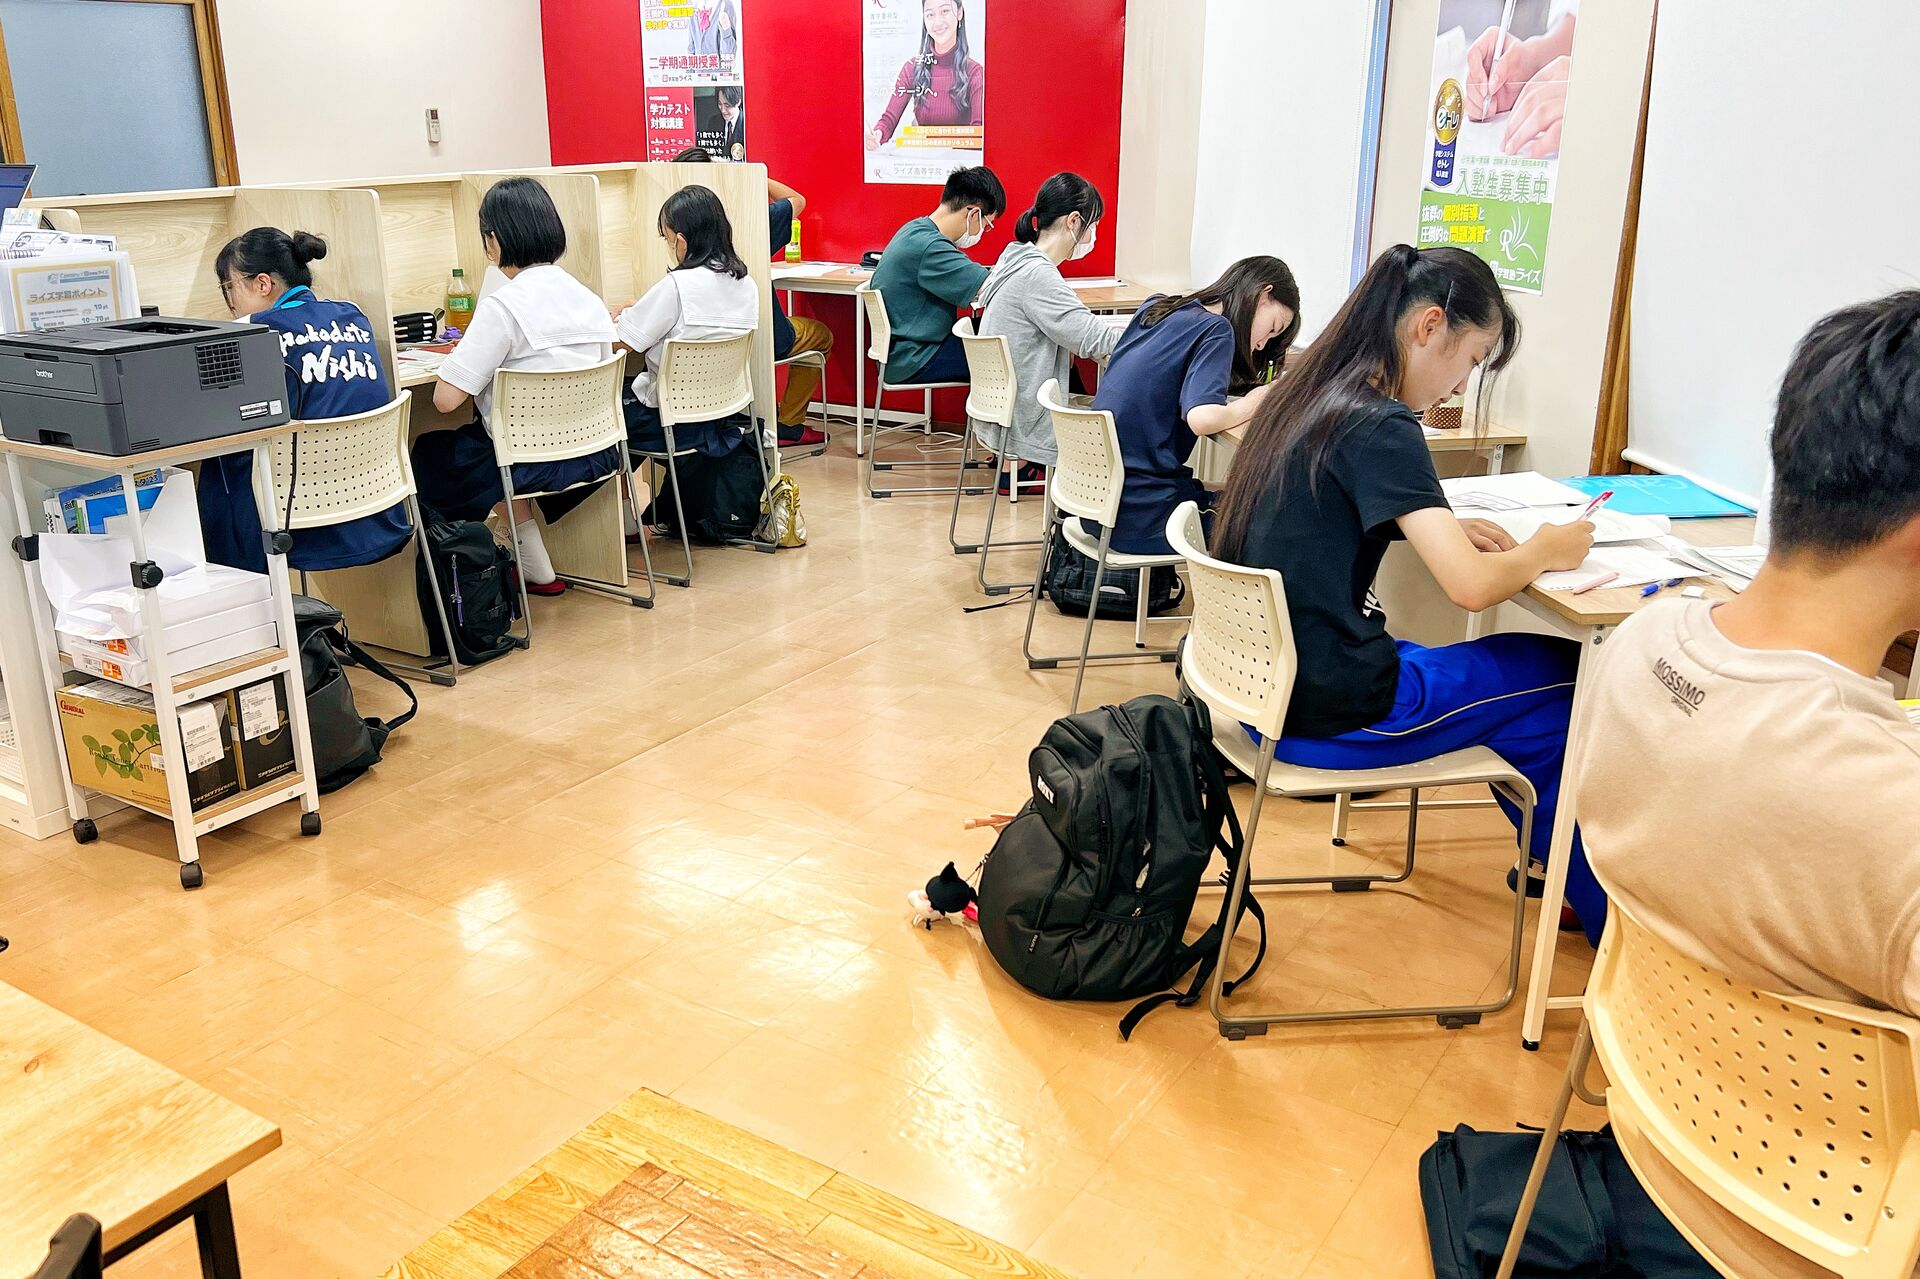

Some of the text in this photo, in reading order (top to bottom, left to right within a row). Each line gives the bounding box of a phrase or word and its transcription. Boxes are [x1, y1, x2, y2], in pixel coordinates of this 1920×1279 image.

[650, 103, 691, 116] 学力テスト
[650, 117, 685, 129] 対策講座
[1456, 169, 1549, 204] 入塾生募集中
[1421, 203, 1485, 222] 抜群の個別指導と
[1420, 225, 1491, 243] 圧倒的な問題演習で
[301, 344, 378, 384] Nishi
[35, 369, 53, 378] brother
[1653, 657, 1706, 705] MOSSIMO
